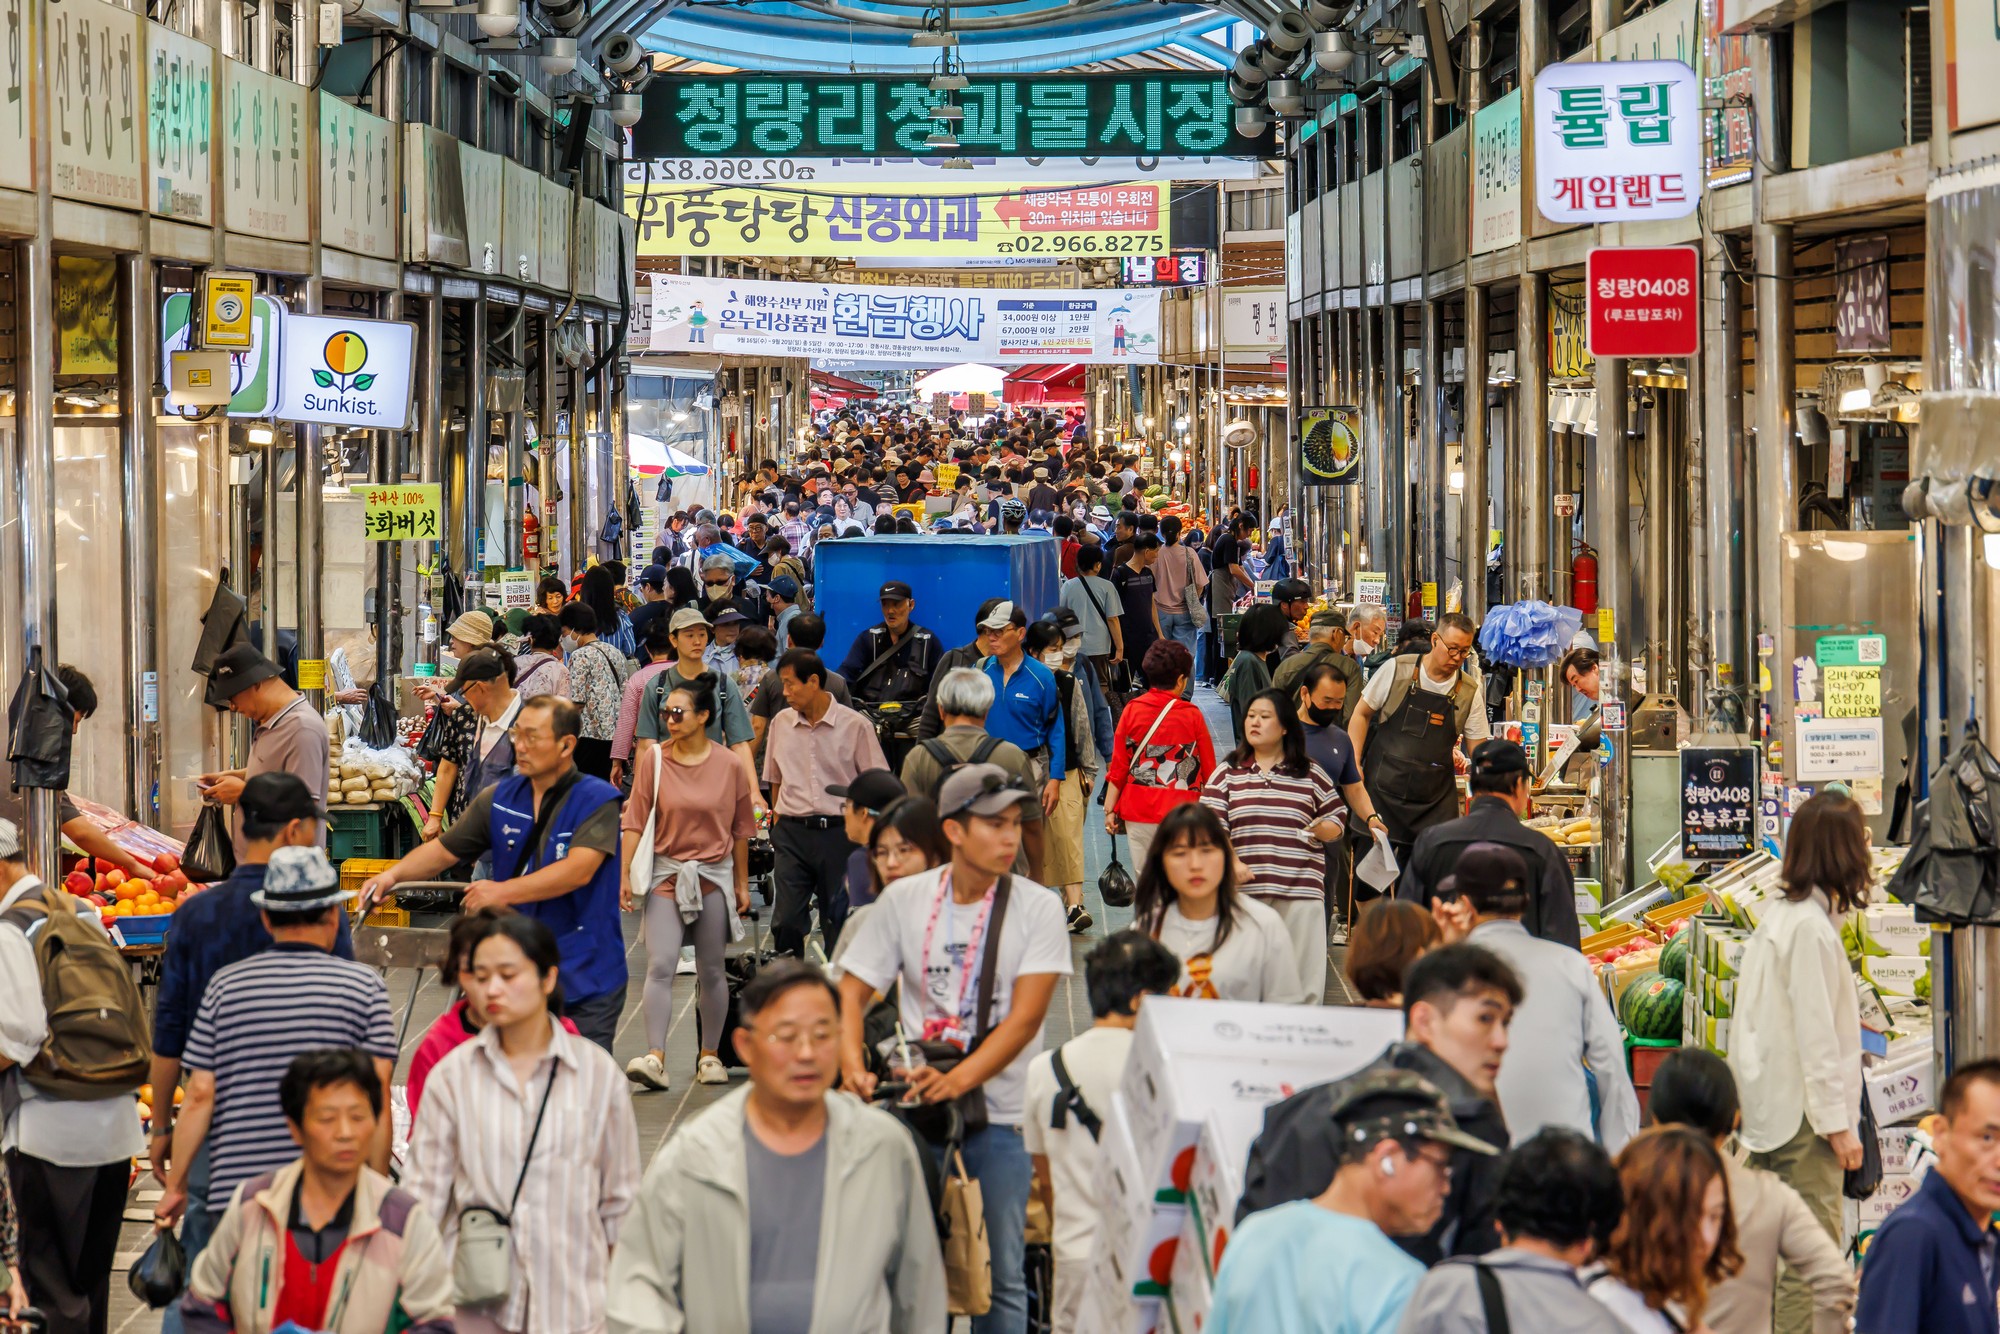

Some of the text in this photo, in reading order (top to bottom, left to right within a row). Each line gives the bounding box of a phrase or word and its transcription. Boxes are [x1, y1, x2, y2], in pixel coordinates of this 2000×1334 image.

[1547, 80, 1682, 150] 튤립
[232, 81, 299, 206] 남양유통
[330, 115, 388, 228] 광주상회
[1024, 190, 1153, 207] 세광약국 모퉁이 우회전
[1552, 173, 1686, 211] 게임랜드
[635, 191, 818, 247] 위풍당당
[825, 196, 981, 242] 신경외과
[1028, 209, 1148, 226] 30m 위치해 있습니다
[1015, 235, 1163, 253] 02.966.8275
[1597, 277, 1690, 299] 청량0408
[745, 294, 827, 312] 해양수산부 지원
[1022, 302, 1035, 310] 기준
[719, 309, 827, 334] 온누리상품권
[833, 293, 985, 341] 환급행사
[1003, 313, 1090, 322] 34,000원 이상 1만원
[1604, 307, 1683, 323] (루프탑포차)
[1002, 325, 1089, 335] 67,000원 이상 2만원
[303, 393, 378, 416] Sunkist
[368, 491, 425, 506] 국내산 100%
[506, 585, 530, 594] 환급행사
[506, 594, 531, 604] 참여점포
[1685, 785, 1751, 805] 청량0408
[1685, 808, 1751, 830] 오늘휴무
